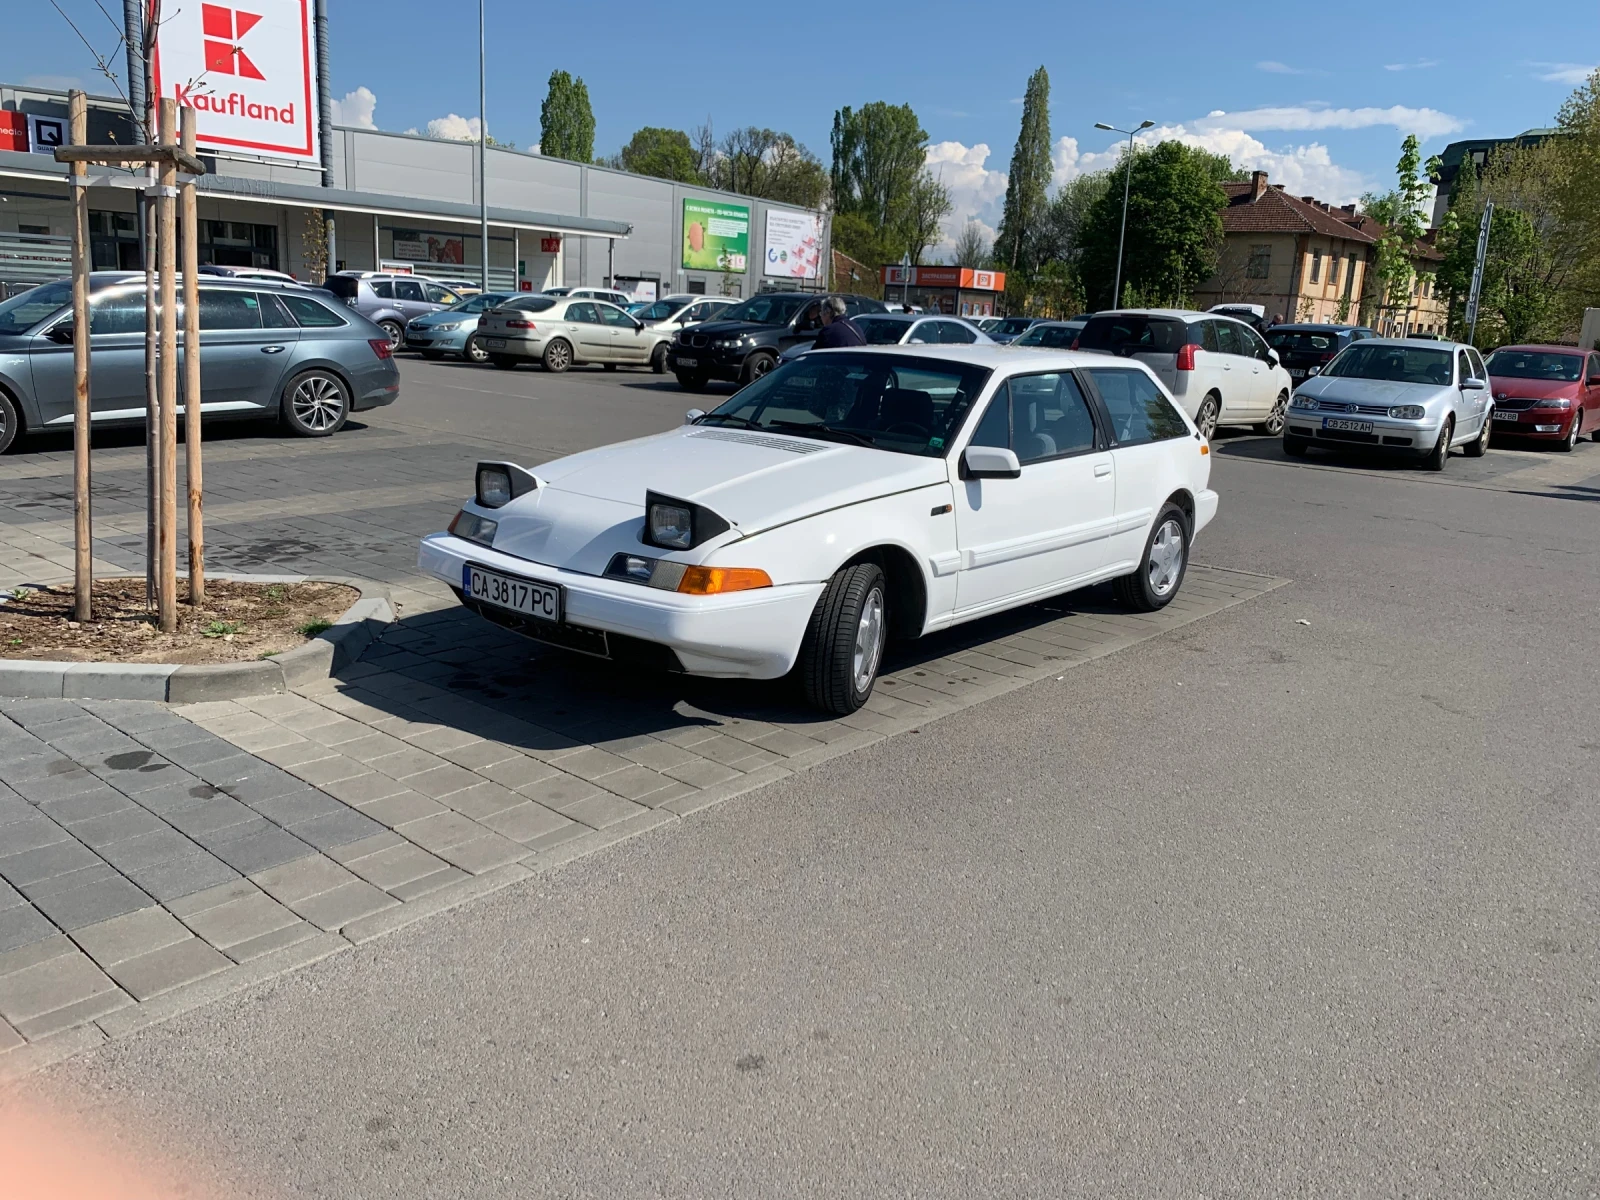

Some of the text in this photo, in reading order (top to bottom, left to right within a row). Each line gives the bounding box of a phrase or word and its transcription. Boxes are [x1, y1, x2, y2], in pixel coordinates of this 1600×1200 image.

[175, 83, 295, 125] Kaufland
[472, 572, 554, 616] CA 3817 PC
